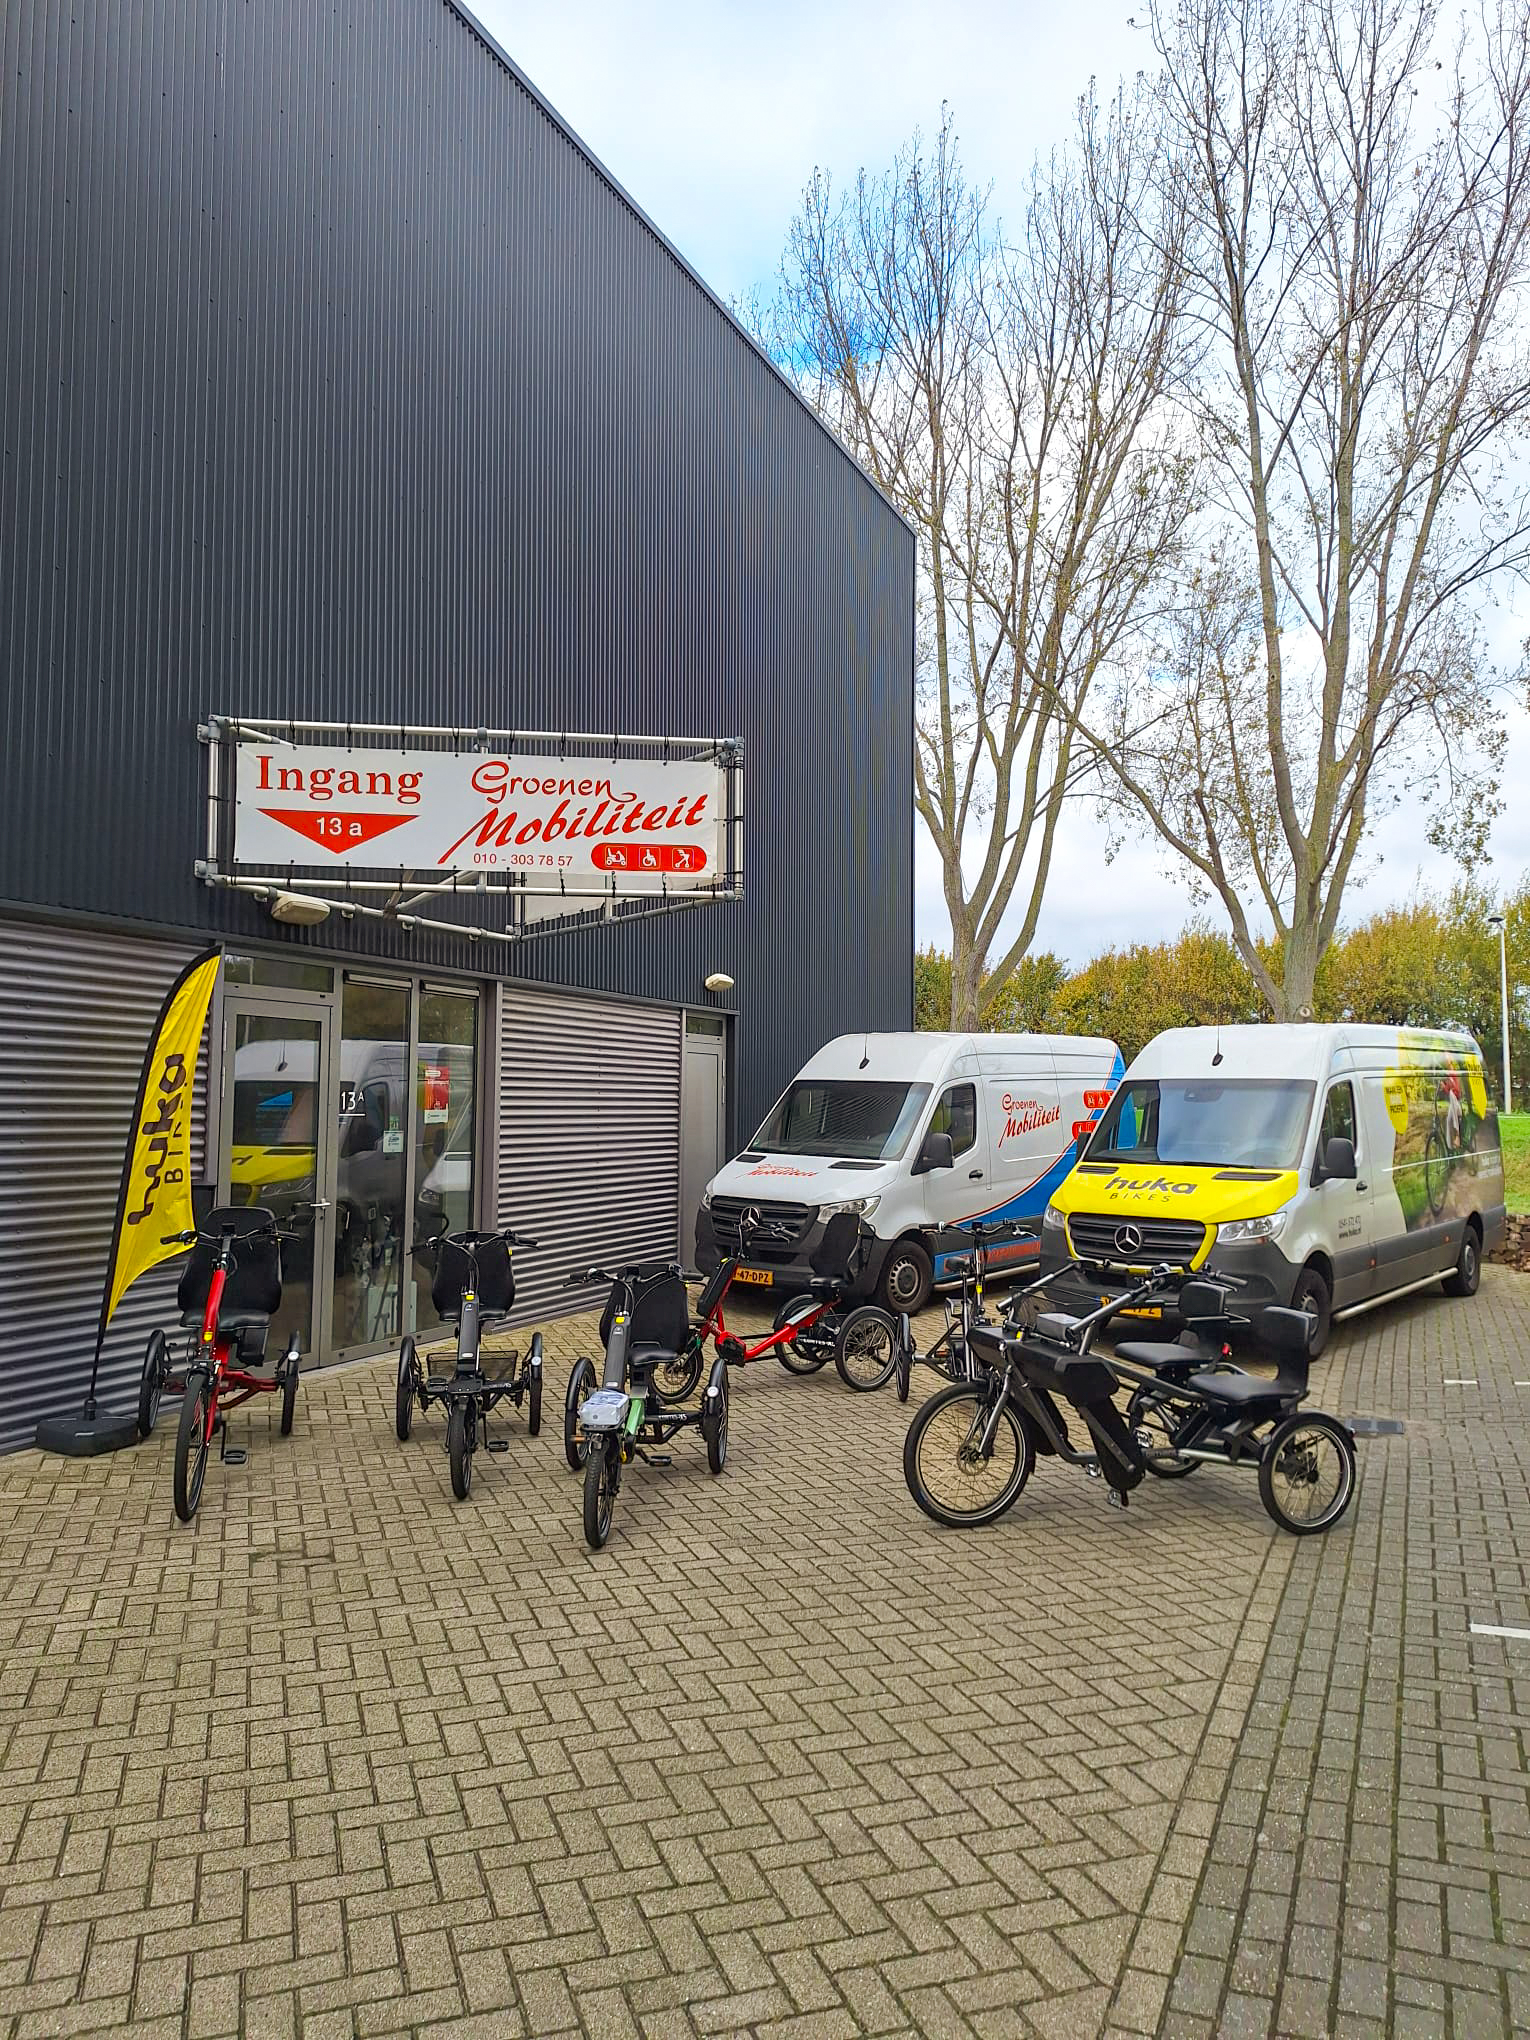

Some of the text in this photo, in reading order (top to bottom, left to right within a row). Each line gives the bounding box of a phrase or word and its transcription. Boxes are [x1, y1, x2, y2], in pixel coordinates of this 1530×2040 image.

[255, 755, 424, 805] Ingang
[471, 760, 638, 804] Groenen
[316, 816, 363, 837] 13 a
[437, 794, 709, 865] Mobiliteit
[473, 852, 498, 865] 010
[510, 853, 534, 866] 303
[538, 854, 555, 867] 78
[557, 855, 574, 867] 57
[1001, 1093, 1044, 1116] Groenen
[998, 1104, 1061, 1149] Mobiliteit
[1103, 1176, 1199, 1195] huka
[1109, 1192, 1172, 1203] BIKES
[734, 1269, 770, 1284] -47-DPZ
